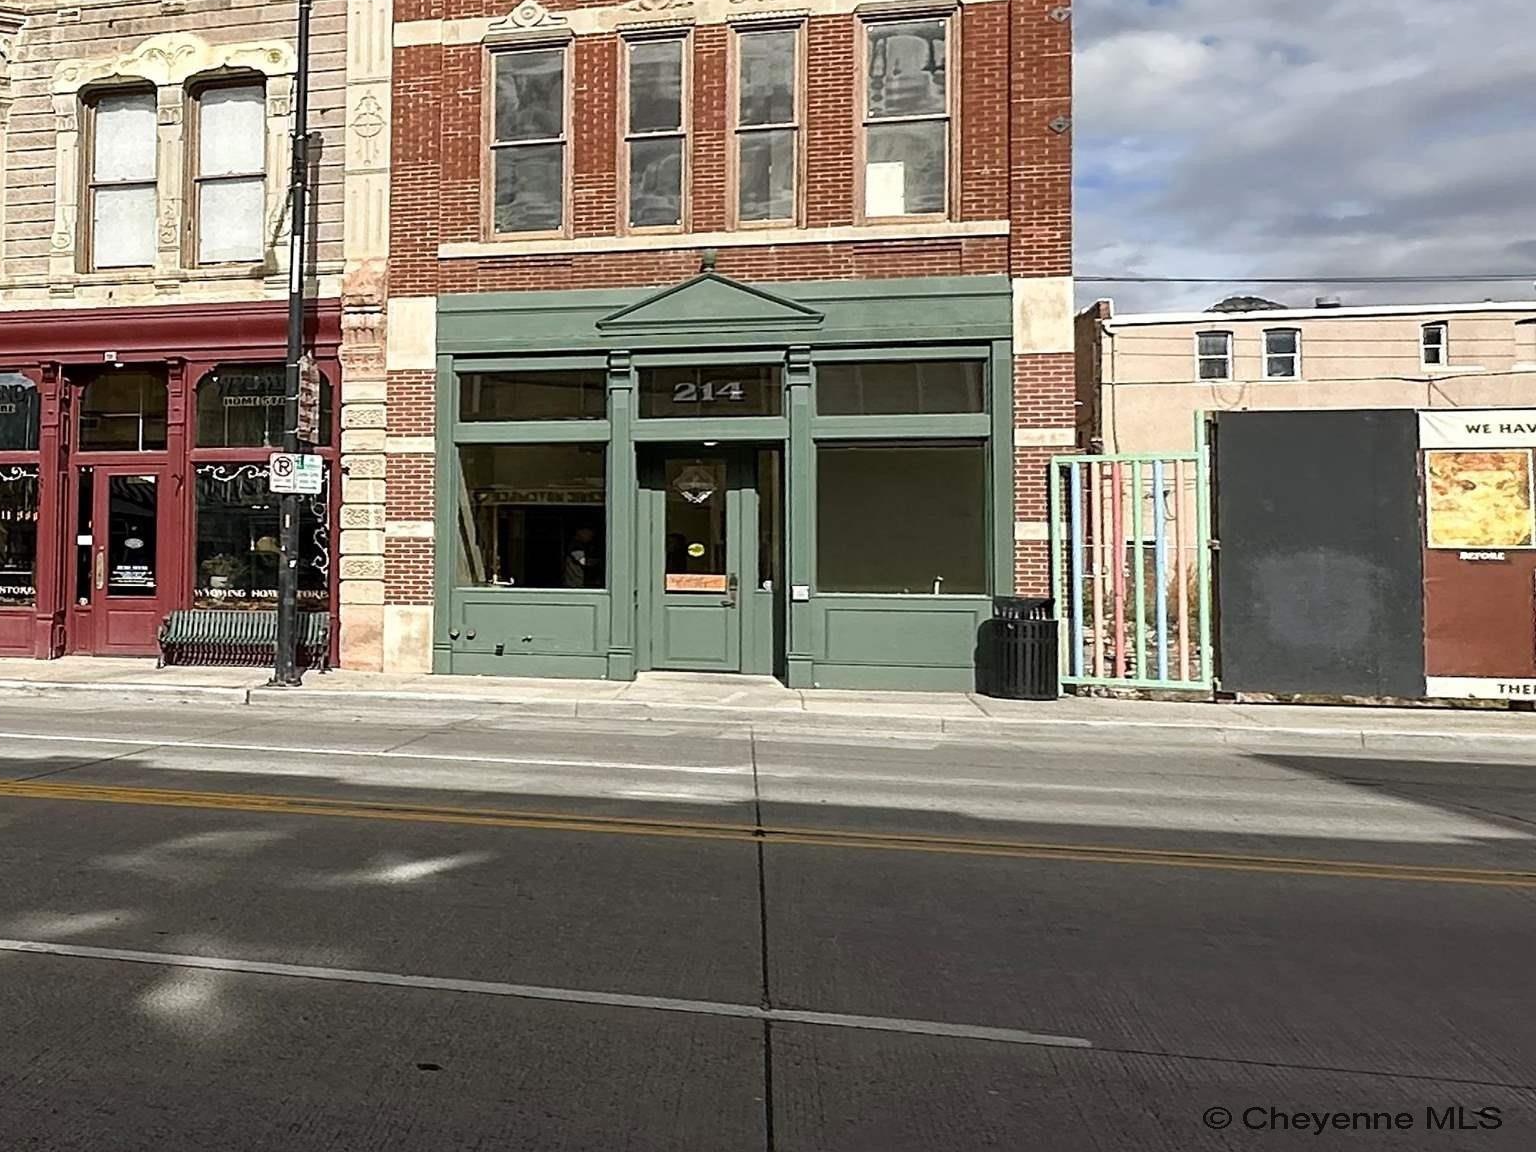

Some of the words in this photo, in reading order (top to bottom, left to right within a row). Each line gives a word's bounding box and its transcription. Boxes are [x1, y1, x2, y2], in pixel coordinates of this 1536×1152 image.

[672, 382, 743, 402] 214
[1465, 423, 1492, 435] WE
[1500, 423, 1536, 435] HAV
[251, 589, 280, 598] HOM
[296, 589, 330, 599] TORE
